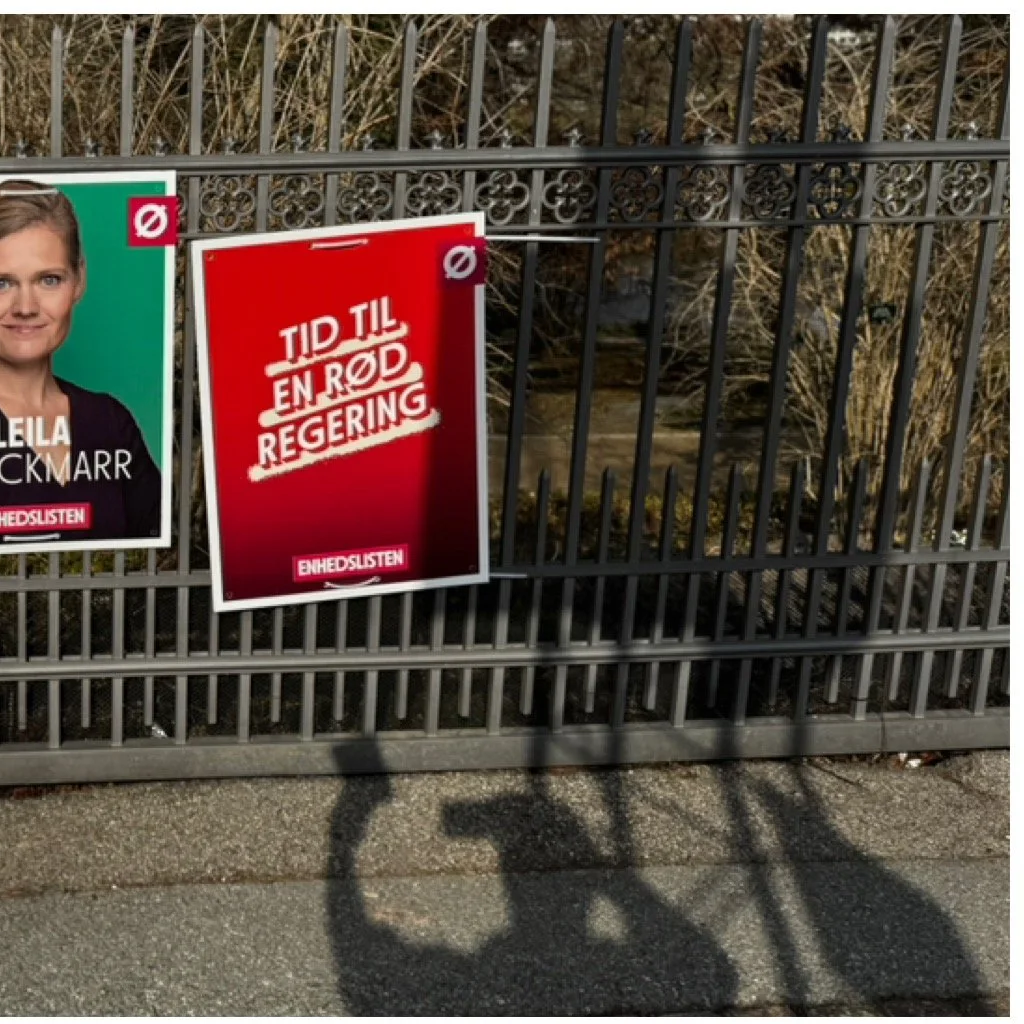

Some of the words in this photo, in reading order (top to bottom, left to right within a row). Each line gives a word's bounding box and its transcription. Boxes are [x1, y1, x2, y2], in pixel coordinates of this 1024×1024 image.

[279, 314, 340, 362] TID
[349, 295, 398, 341] TIL
[273, 372, 313, 416] EN
[324, 343, 408, 400] RØD
[257, 381, 428, 467] REGERING
[297, 548, 404, 577] ENHEDSLISTEN
